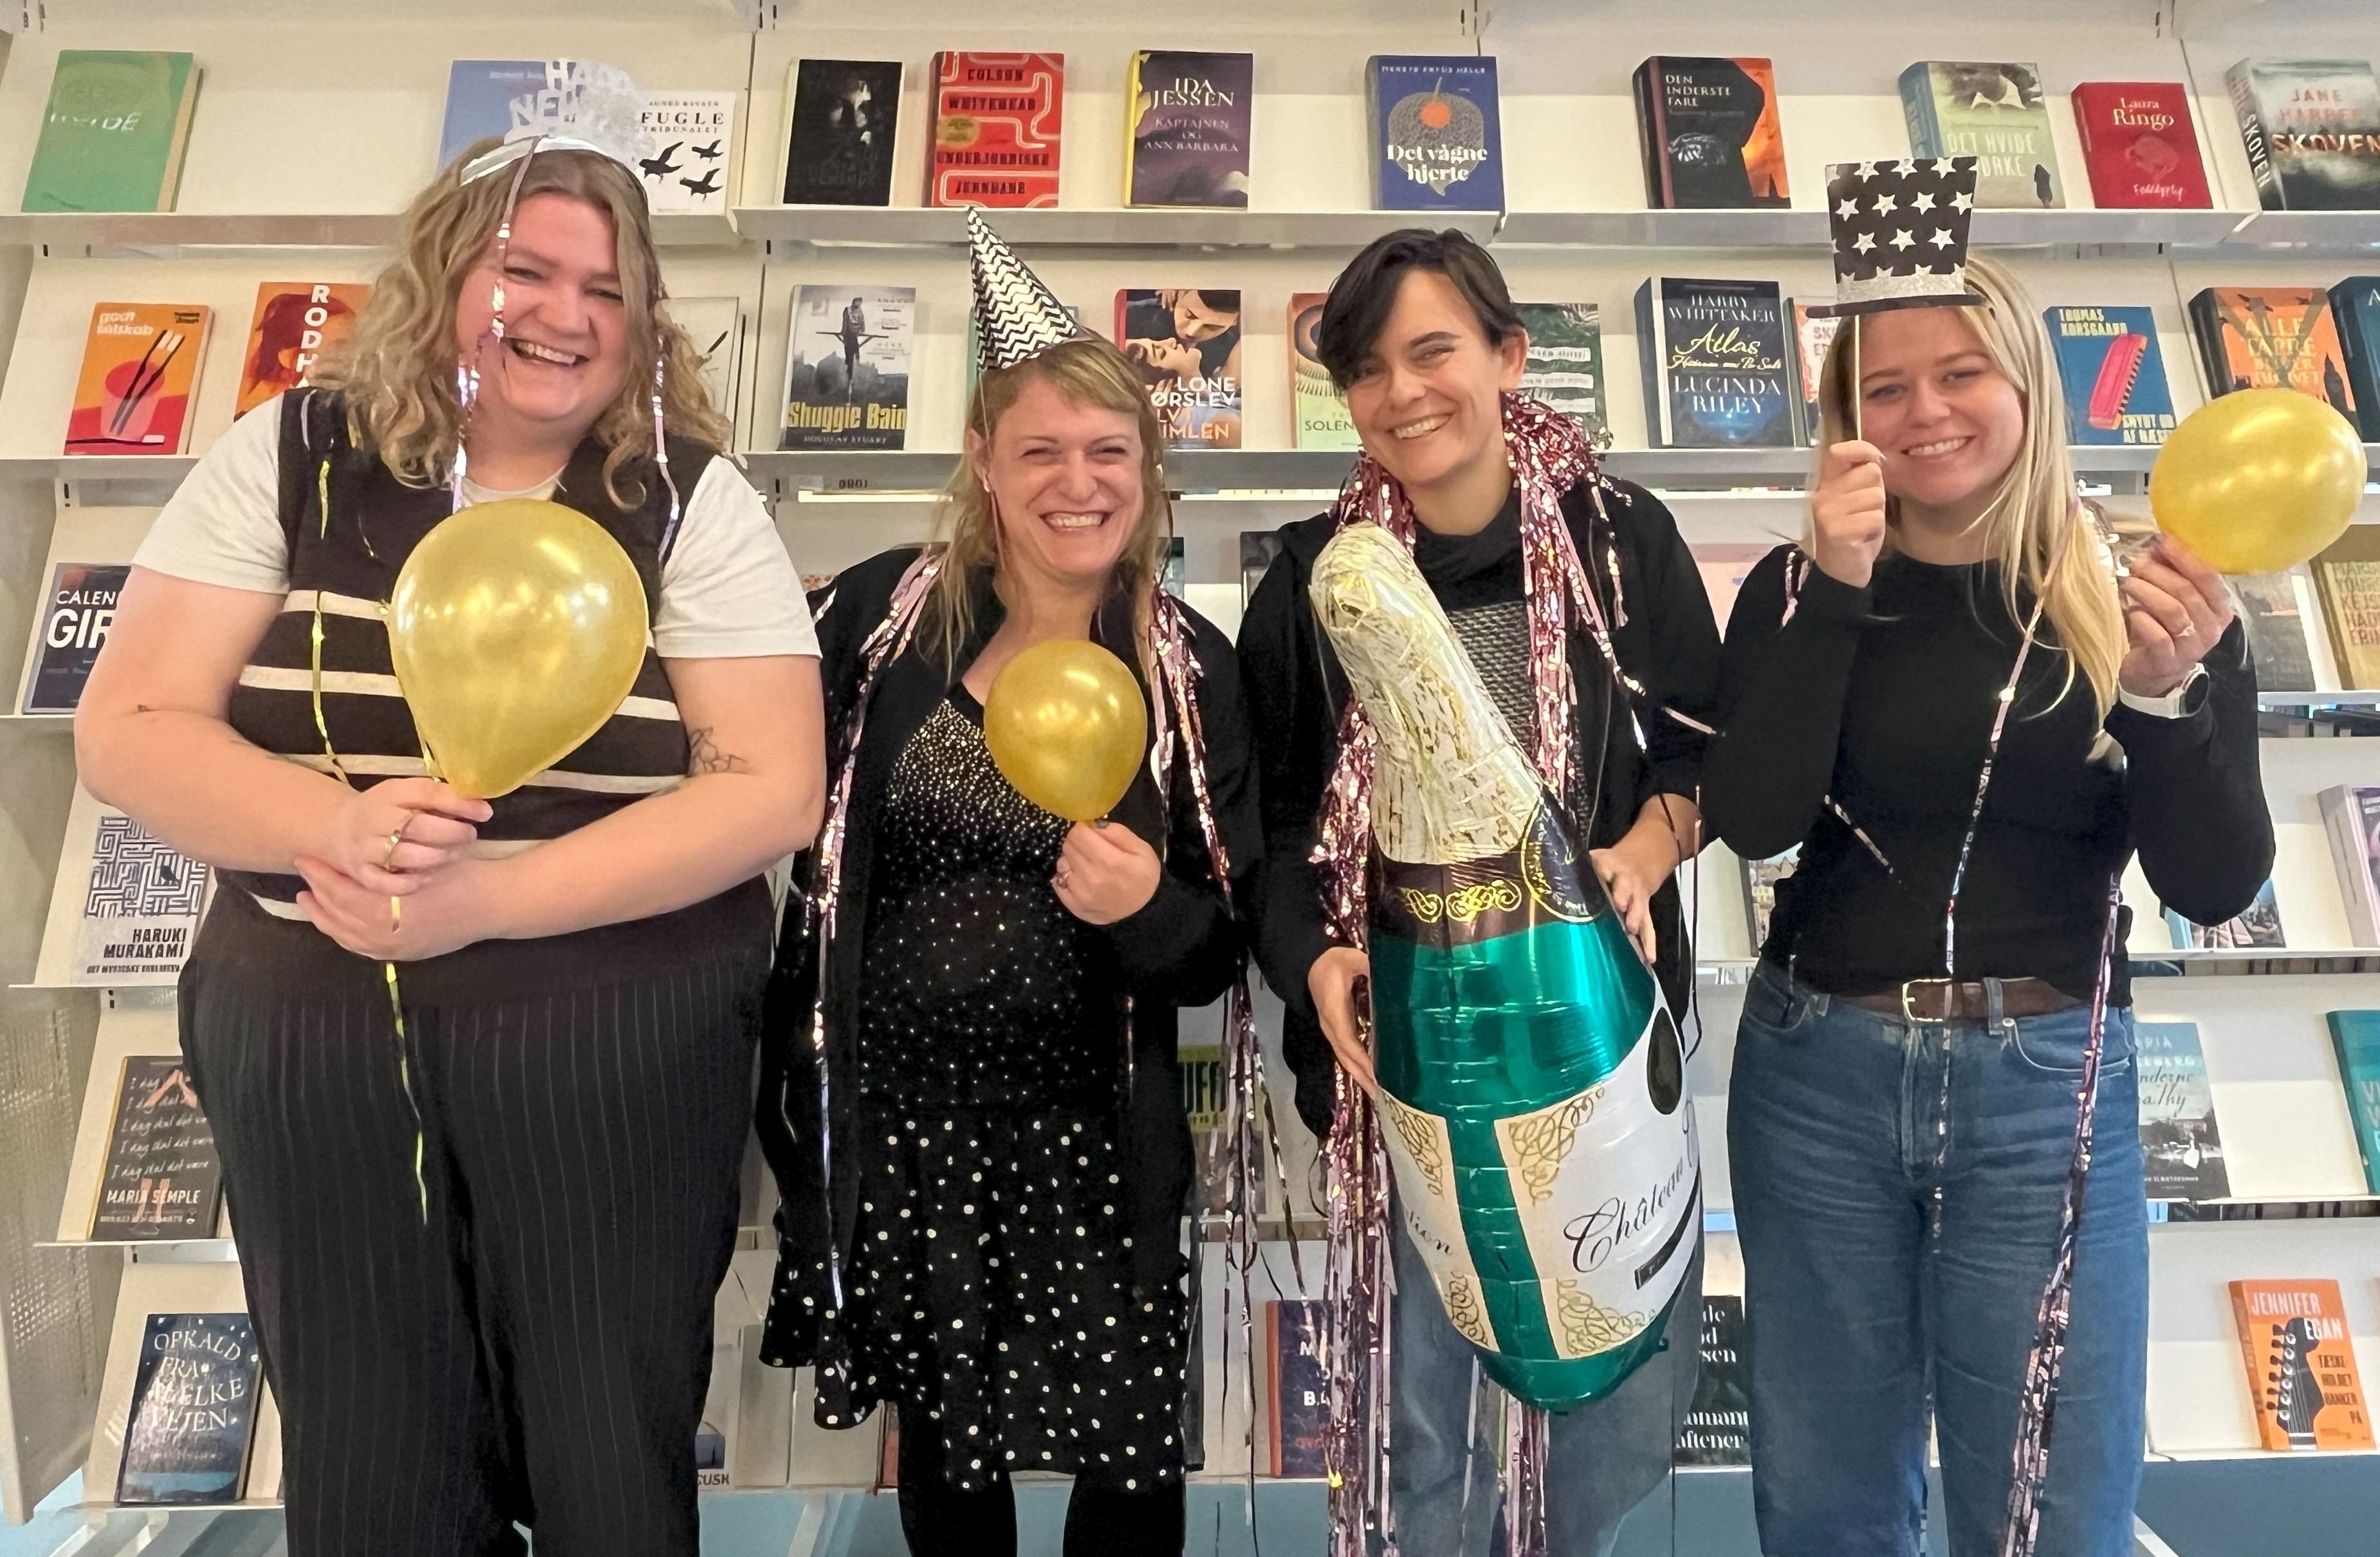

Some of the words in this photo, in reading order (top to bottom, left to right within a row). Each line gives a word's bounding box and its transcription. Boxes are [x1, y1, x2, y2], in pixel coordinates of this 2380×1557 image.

[1175, 78, 1213, 95] IDA
[1665, 74, 1693, 84] DEN
[1153, 89, 1235, 109] JESSEN
[1666, 86, 1731, 96] INDERSTE
[2291, 89, 2343, 102] JANE
[2120, 97, 2159, 109] Laura
[641, 111, 724, 125] FUGLE
[2113, 108, 2175, 131] Ringo
[1387, 144, 1425, 161] Det
[1427, 143, 1488, 164] vågne
[2243, 113, 2272, 189] SKOVEN
[1407, 163, 1469, 185] hjerte
[1692, 294, 1748, 308] HARRY
[1669, 307, 1775, 322] WHITTAKER
[1675, 322, 1761, 355] Atlas
[1177, 376, 1236, 392] LONE
[1674, 375, 1781, 396] LUCINDA
[1150, 391, 1236, 407] ØRSLEV
[1693, 395, 1764, 414] RILEY
[788, 401, 862, 433] Shuggie
[866, 403, 907, 430] Bain
[1305, 420, 1354, 431] SOLEN
[1162, 422, 1229, 440] IMLEN
[55, 590, 116, 605] CALEN
[46, 608, 117, 649] GIR
[133, 928, 188, 943] HARUKI
[103, 943, 185, 959] MURAKAMI
[2135, 1035, 2173, 1049] ARIA
[2139, 1066, 2194, 1083] nderne
[2251, 1291, 2322, 1316] JENNIFER
[2303, 1317, 2344, 1340] EGAN
[154, 1330, 241, 1361] OPKALD
